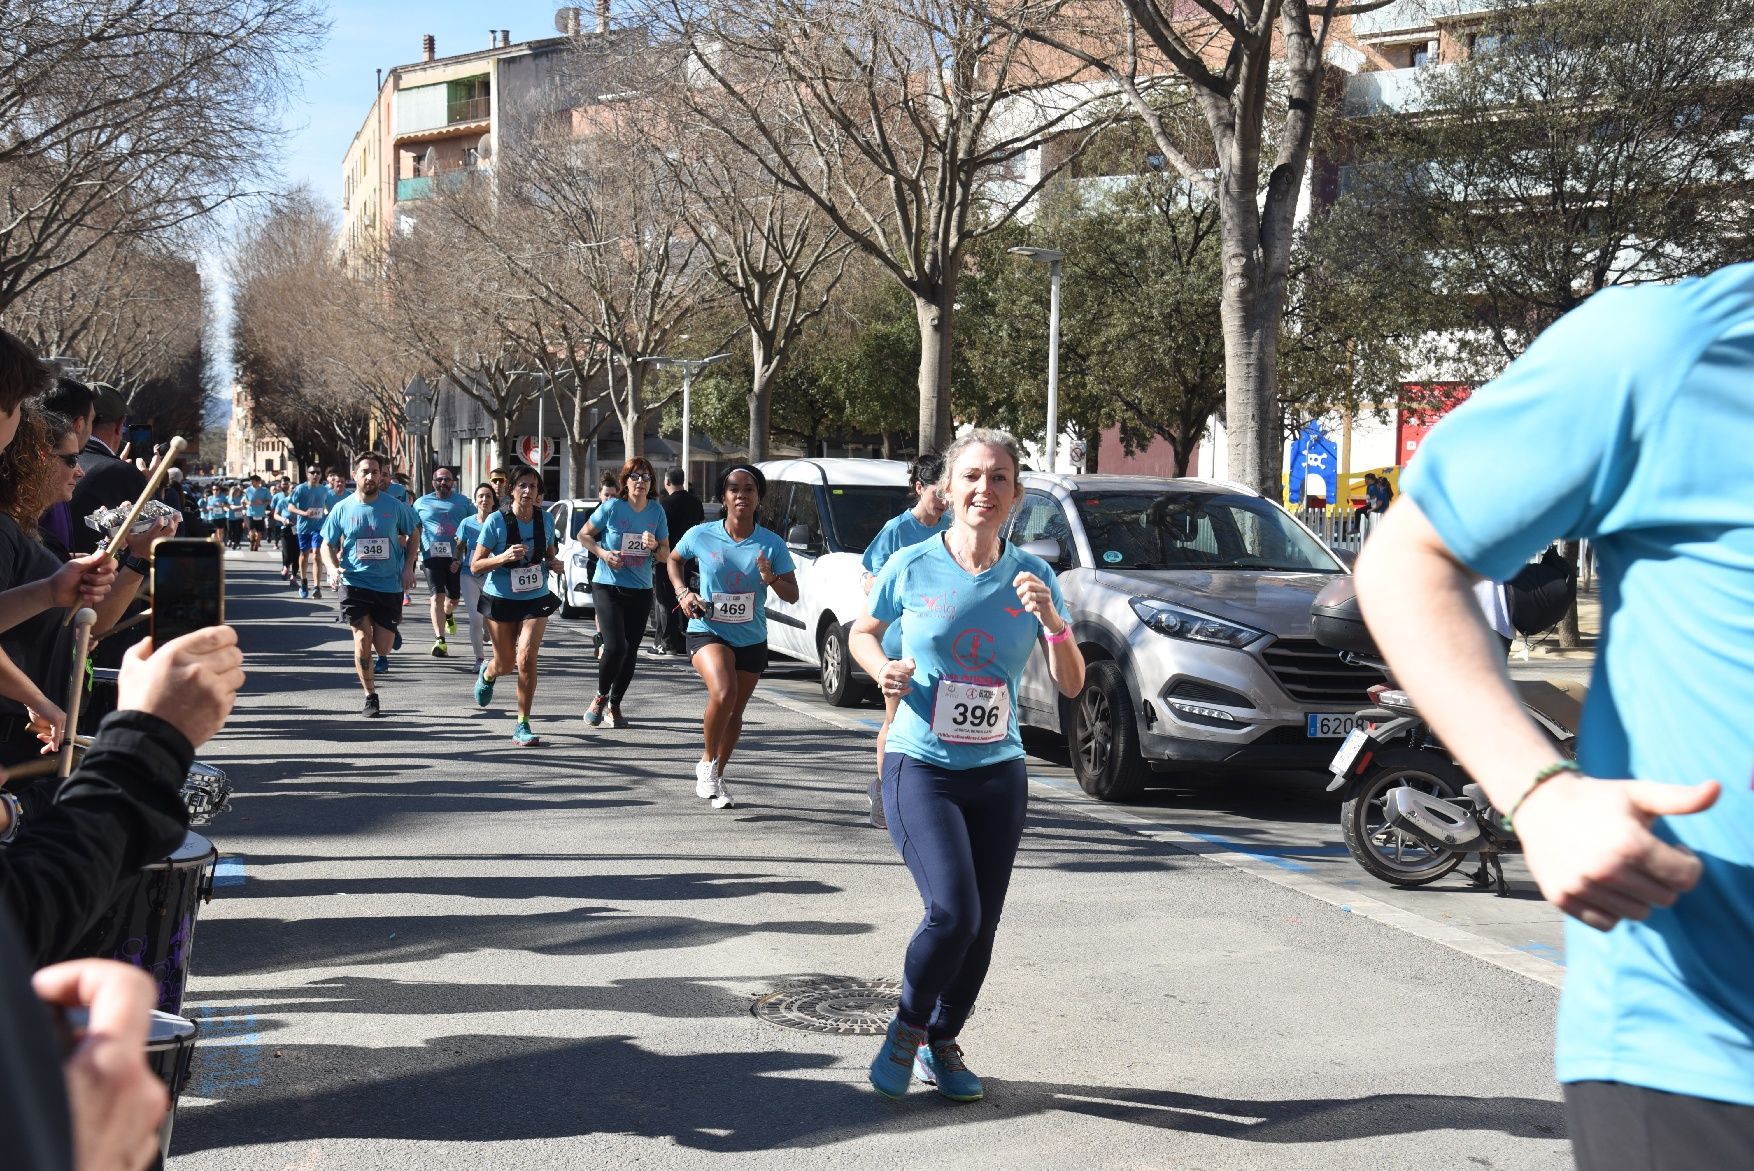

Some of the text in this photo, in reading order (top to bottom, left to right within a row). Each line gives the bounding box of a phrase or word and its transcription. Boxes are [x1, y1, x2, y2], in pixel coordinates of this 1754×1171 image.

[363, 545, 383, 555] 348
[518, 573, 538, 586] 619
[720, 603, 746, 615] 469
[952, 703, 999, 727] 396
[1321, 717, 1364, 735] 6208
